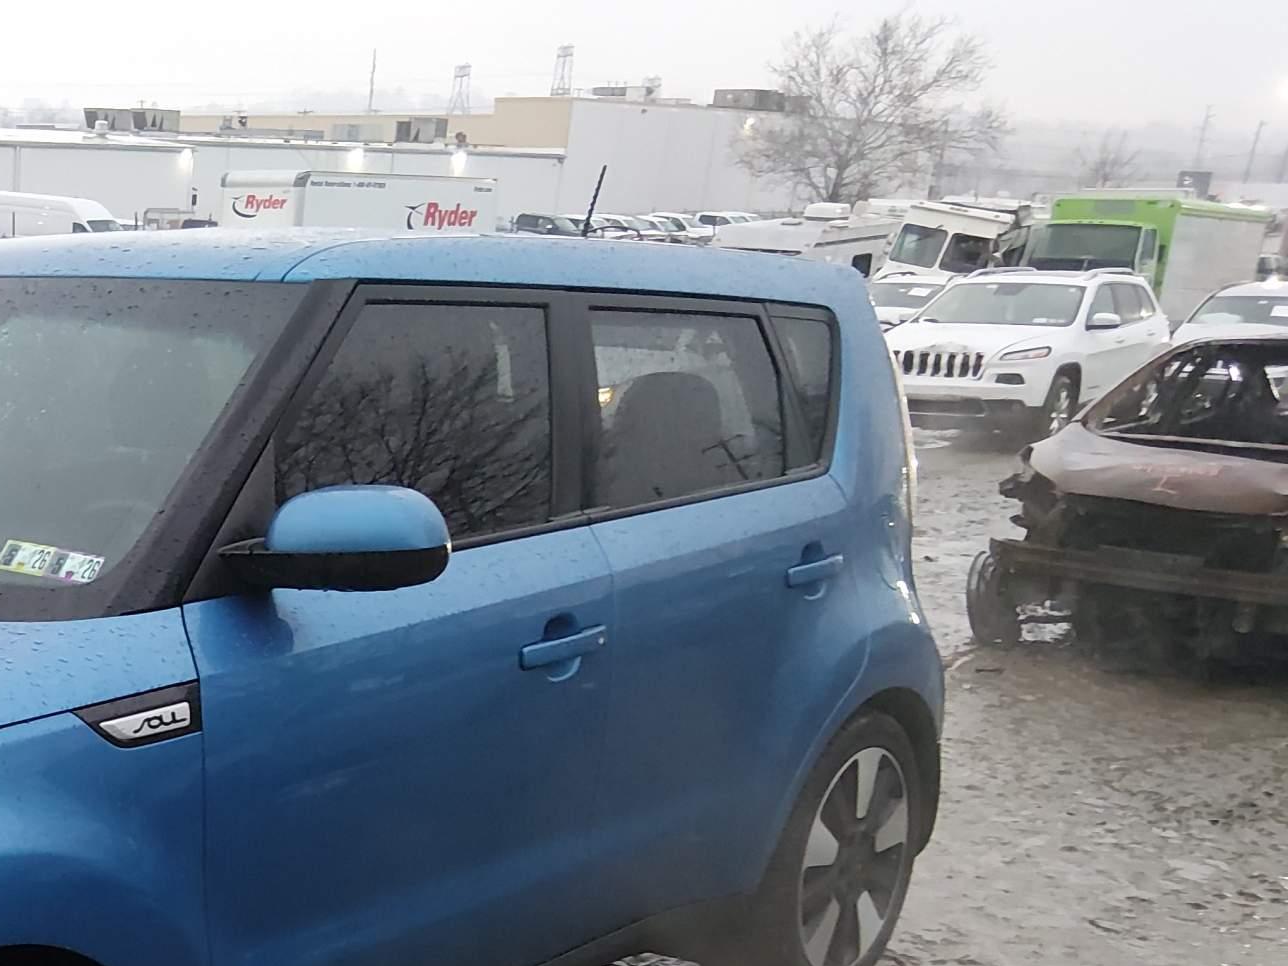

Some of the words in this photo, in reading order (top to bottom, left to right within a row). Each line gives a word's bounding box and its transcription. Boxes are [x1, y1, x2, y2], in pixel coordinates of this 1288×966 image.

[244, 194, 288, 213] Ryder
[423, 202, 478, 231] Ryder
[31, 549, 51, 570] 26
[81, 559, 101, 580] 26
